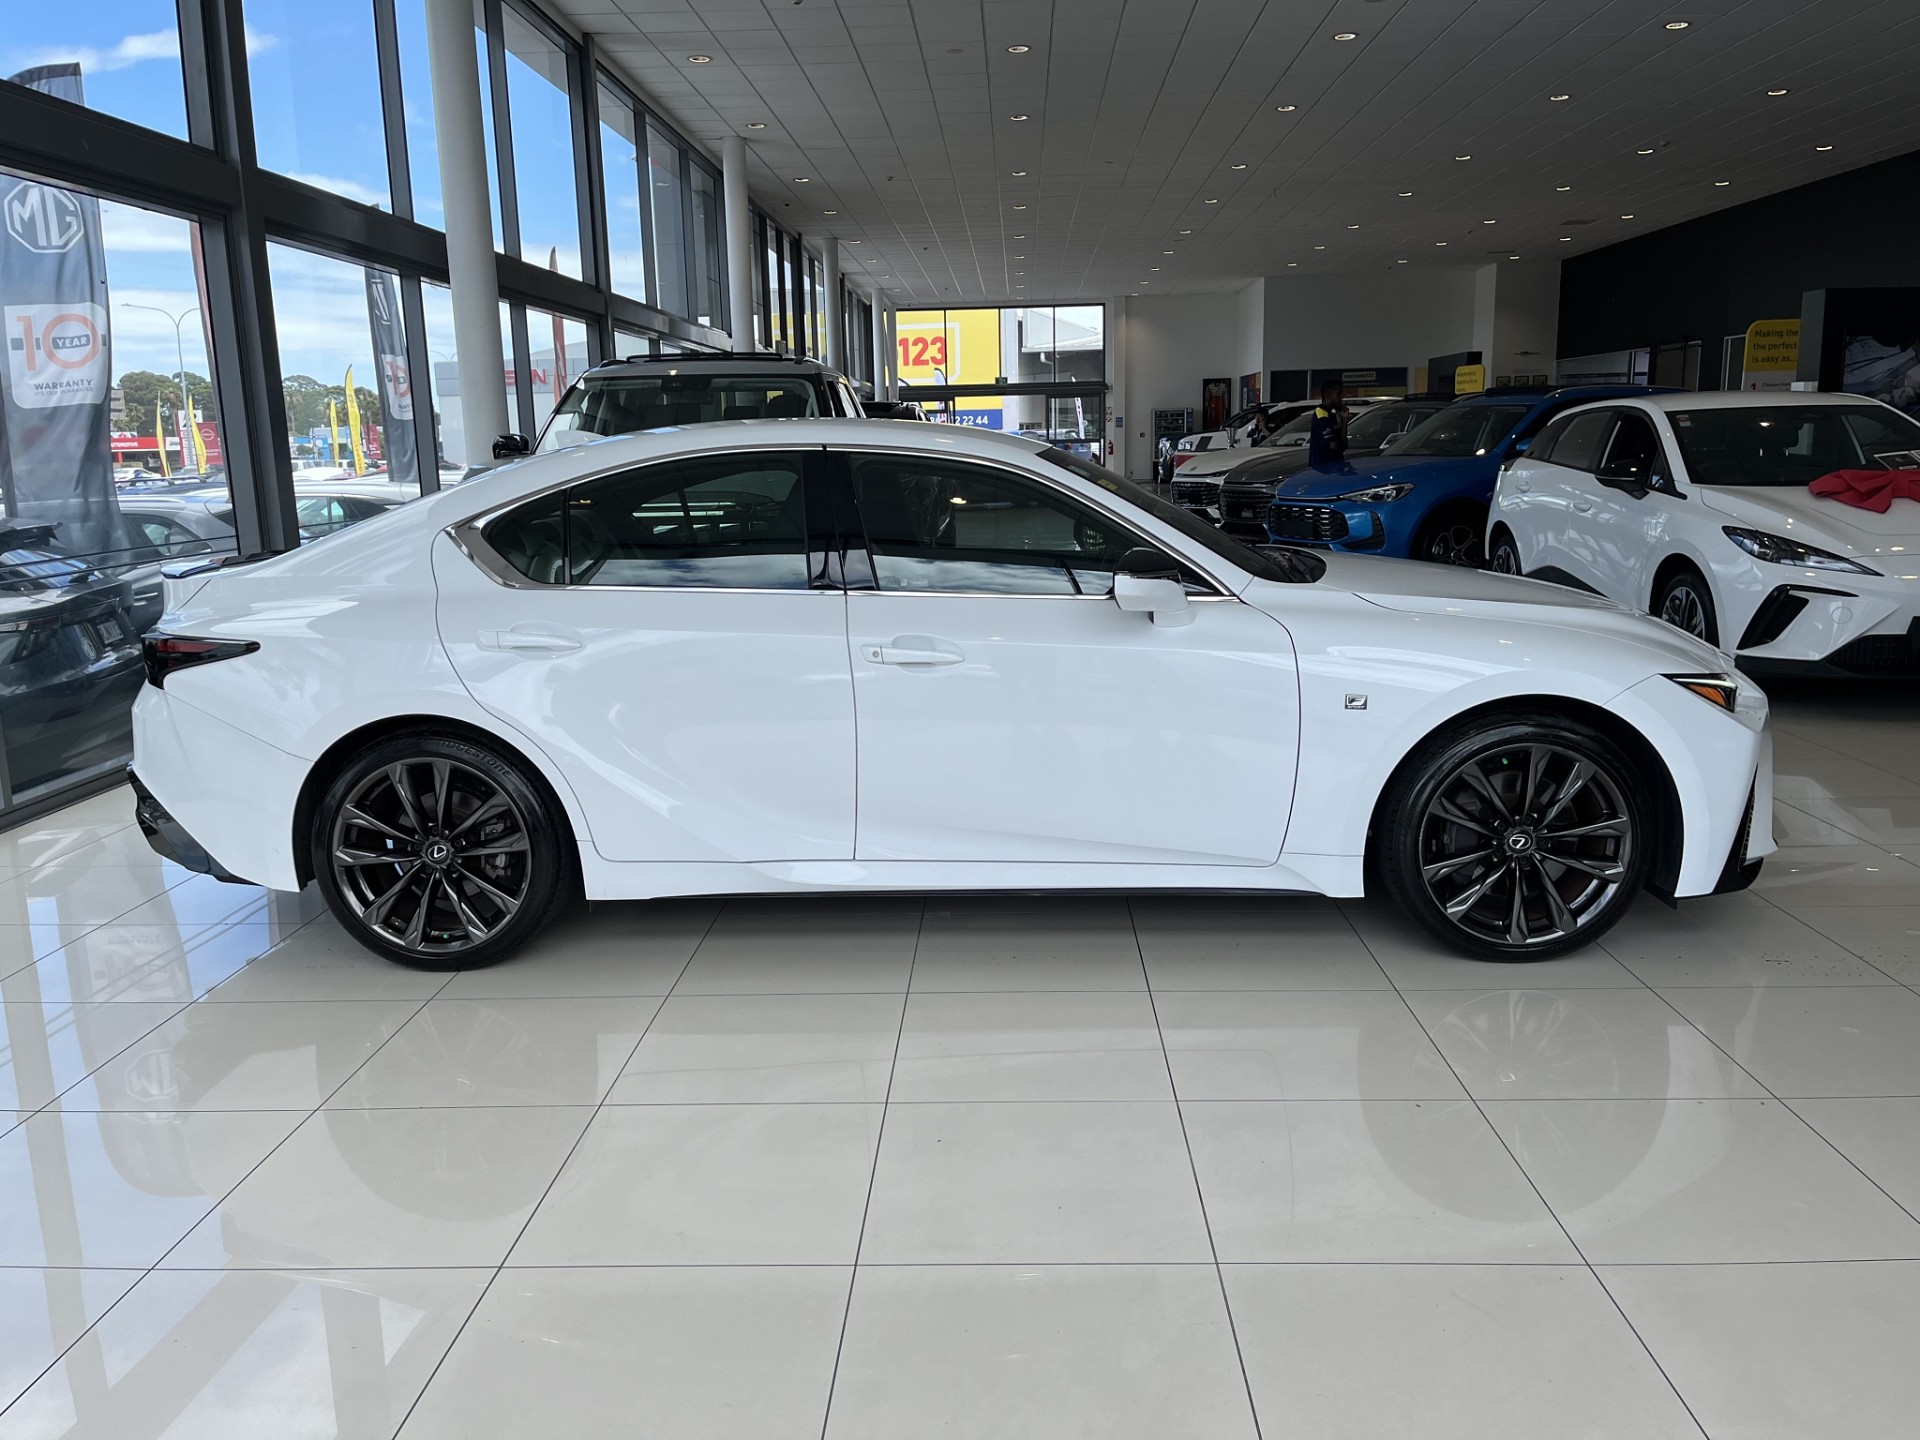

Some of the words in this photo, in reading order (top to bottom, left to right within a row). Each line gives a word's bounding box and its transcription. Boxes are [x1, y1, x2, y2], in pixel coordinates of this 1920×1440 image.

[11, 186, 77, 246] MG
[1754, 329, 1784, 338] Making
[1785, 328, 1799, 337] the
[16, 313, 101, 371] 10
[56, 336, 88, 348] YEAR
[1752, 342, 1766, 350] the
[1767, 341, 1798, 351] perfect
[898, 336, 946, 366] 123
[1751, 355, 1760, 363] is
[1761, 356, 1780, 364] easy
[34, 378, 93, 390] WARRANTY
[962, 415, 974, 426] 22
[975, 415, 989, 425] 44
[427, 739, 512, 778] RIDGESTONE
